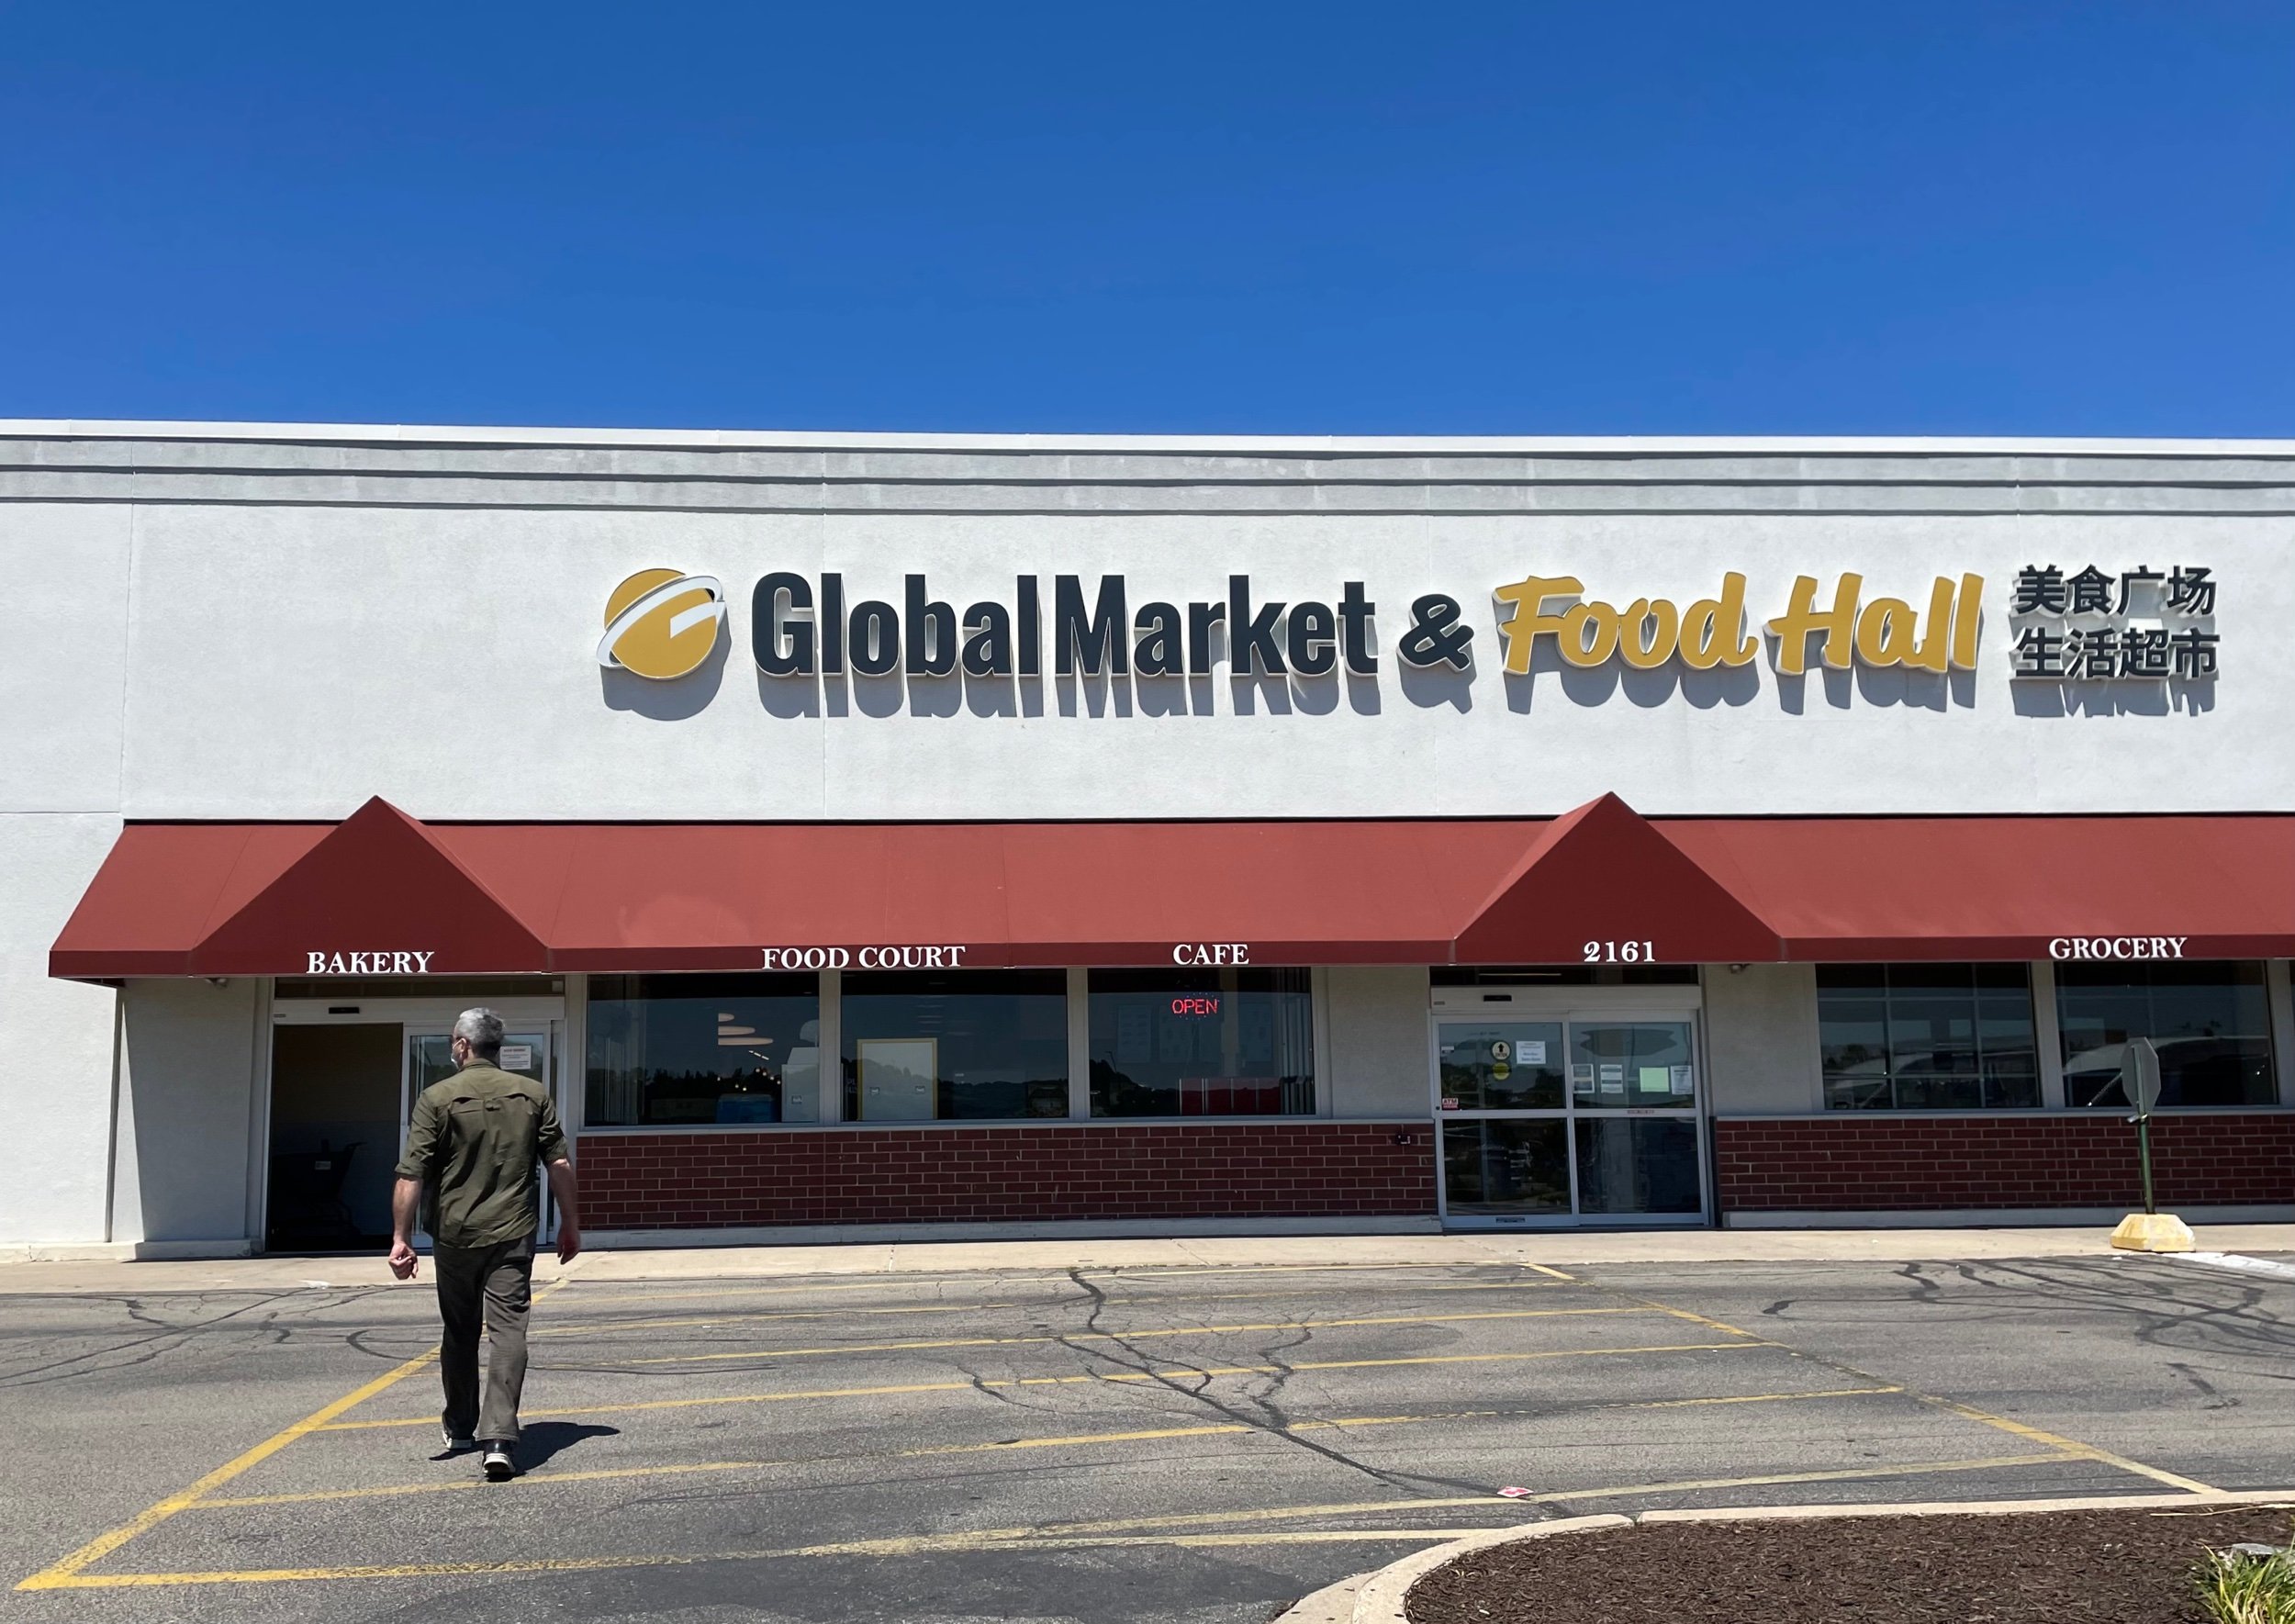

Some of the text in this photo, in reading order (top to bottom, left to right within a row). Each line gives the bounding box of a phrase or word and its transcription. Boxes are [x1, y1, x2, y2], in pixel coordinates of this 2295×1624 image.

[2016, 564, 2217, 616] 美食广场
[752, 571, 1984, 678] Global Market & Food Hall
[2015, 626, 2221, 678] 生活超市
[761, 946, 966, 970] FOOD COURT
[1172, 944, 1249, 966] CAFE
[1584, 940, 1656, 963] 2161
[2049, 936, 2188, 960] GROCERY
[306, 951, 435, 975] BAKERY
[1171, 998, 1218, 1014] OPEN
